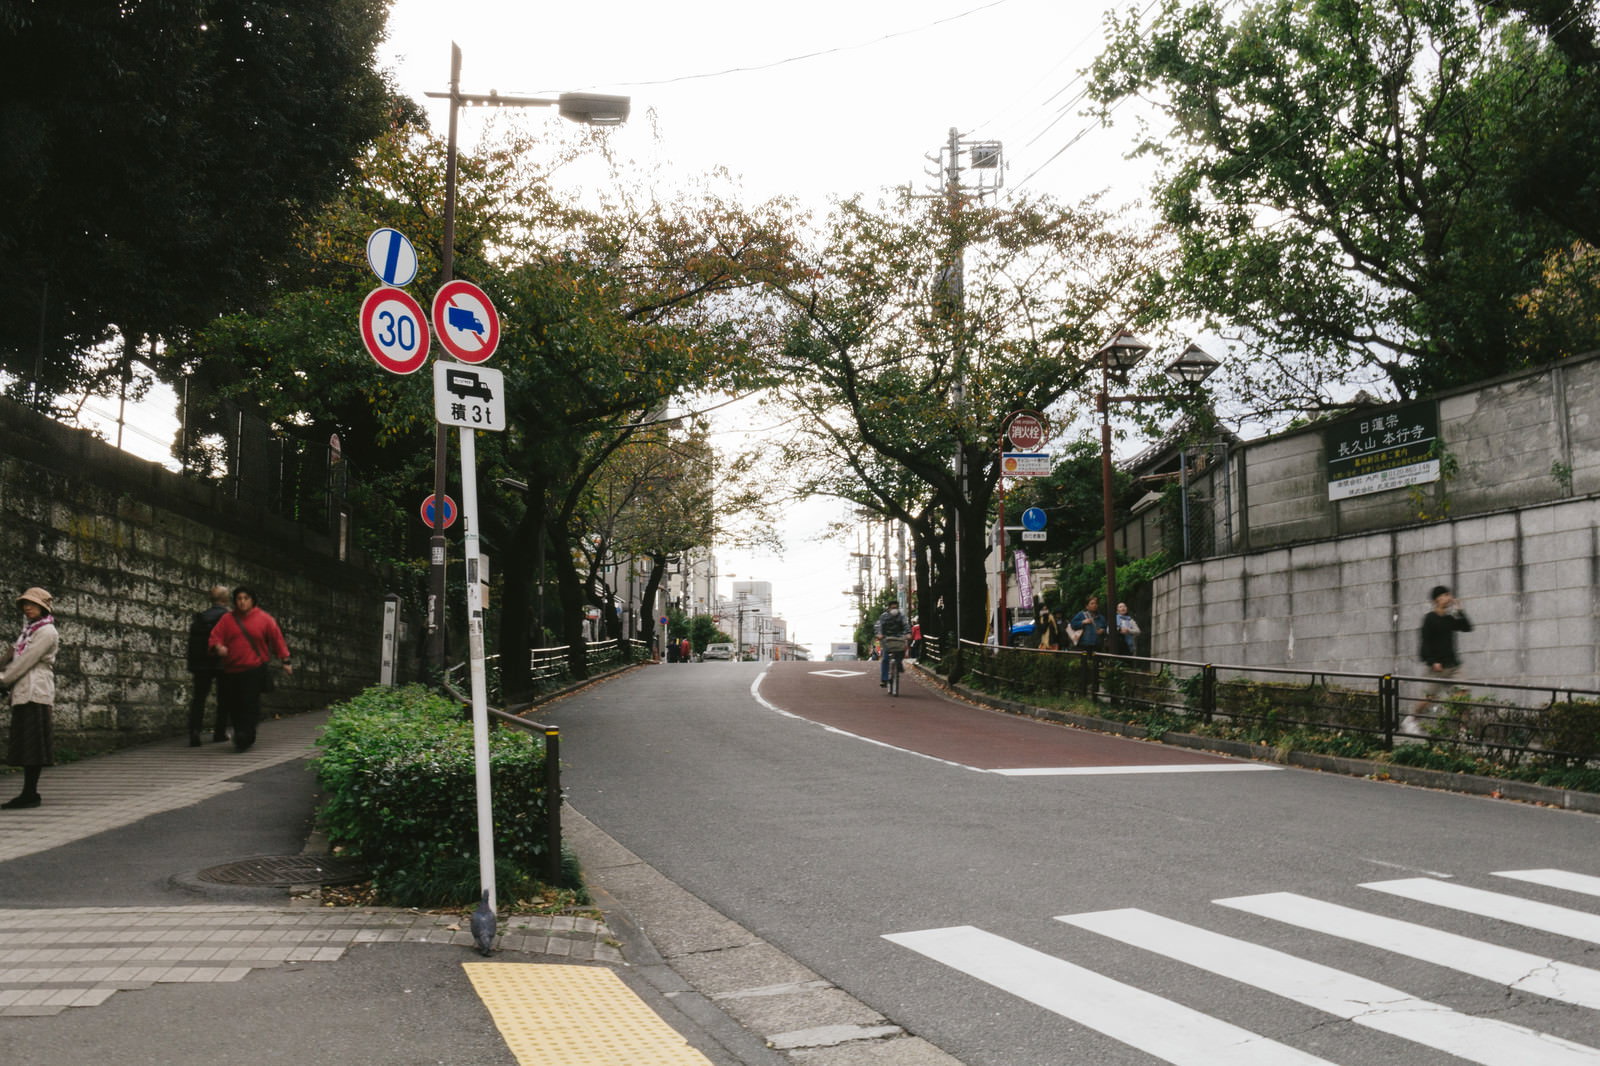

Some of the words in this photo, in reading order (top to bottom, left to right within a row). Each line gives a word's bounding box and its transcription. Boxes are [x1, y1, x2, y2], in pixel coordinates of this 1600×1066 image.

[378, 310, 416, 351] 30
[1011, 426, 1040, 440] 消火栓
[1360, 414, 1399, 434] 日蓮宗
